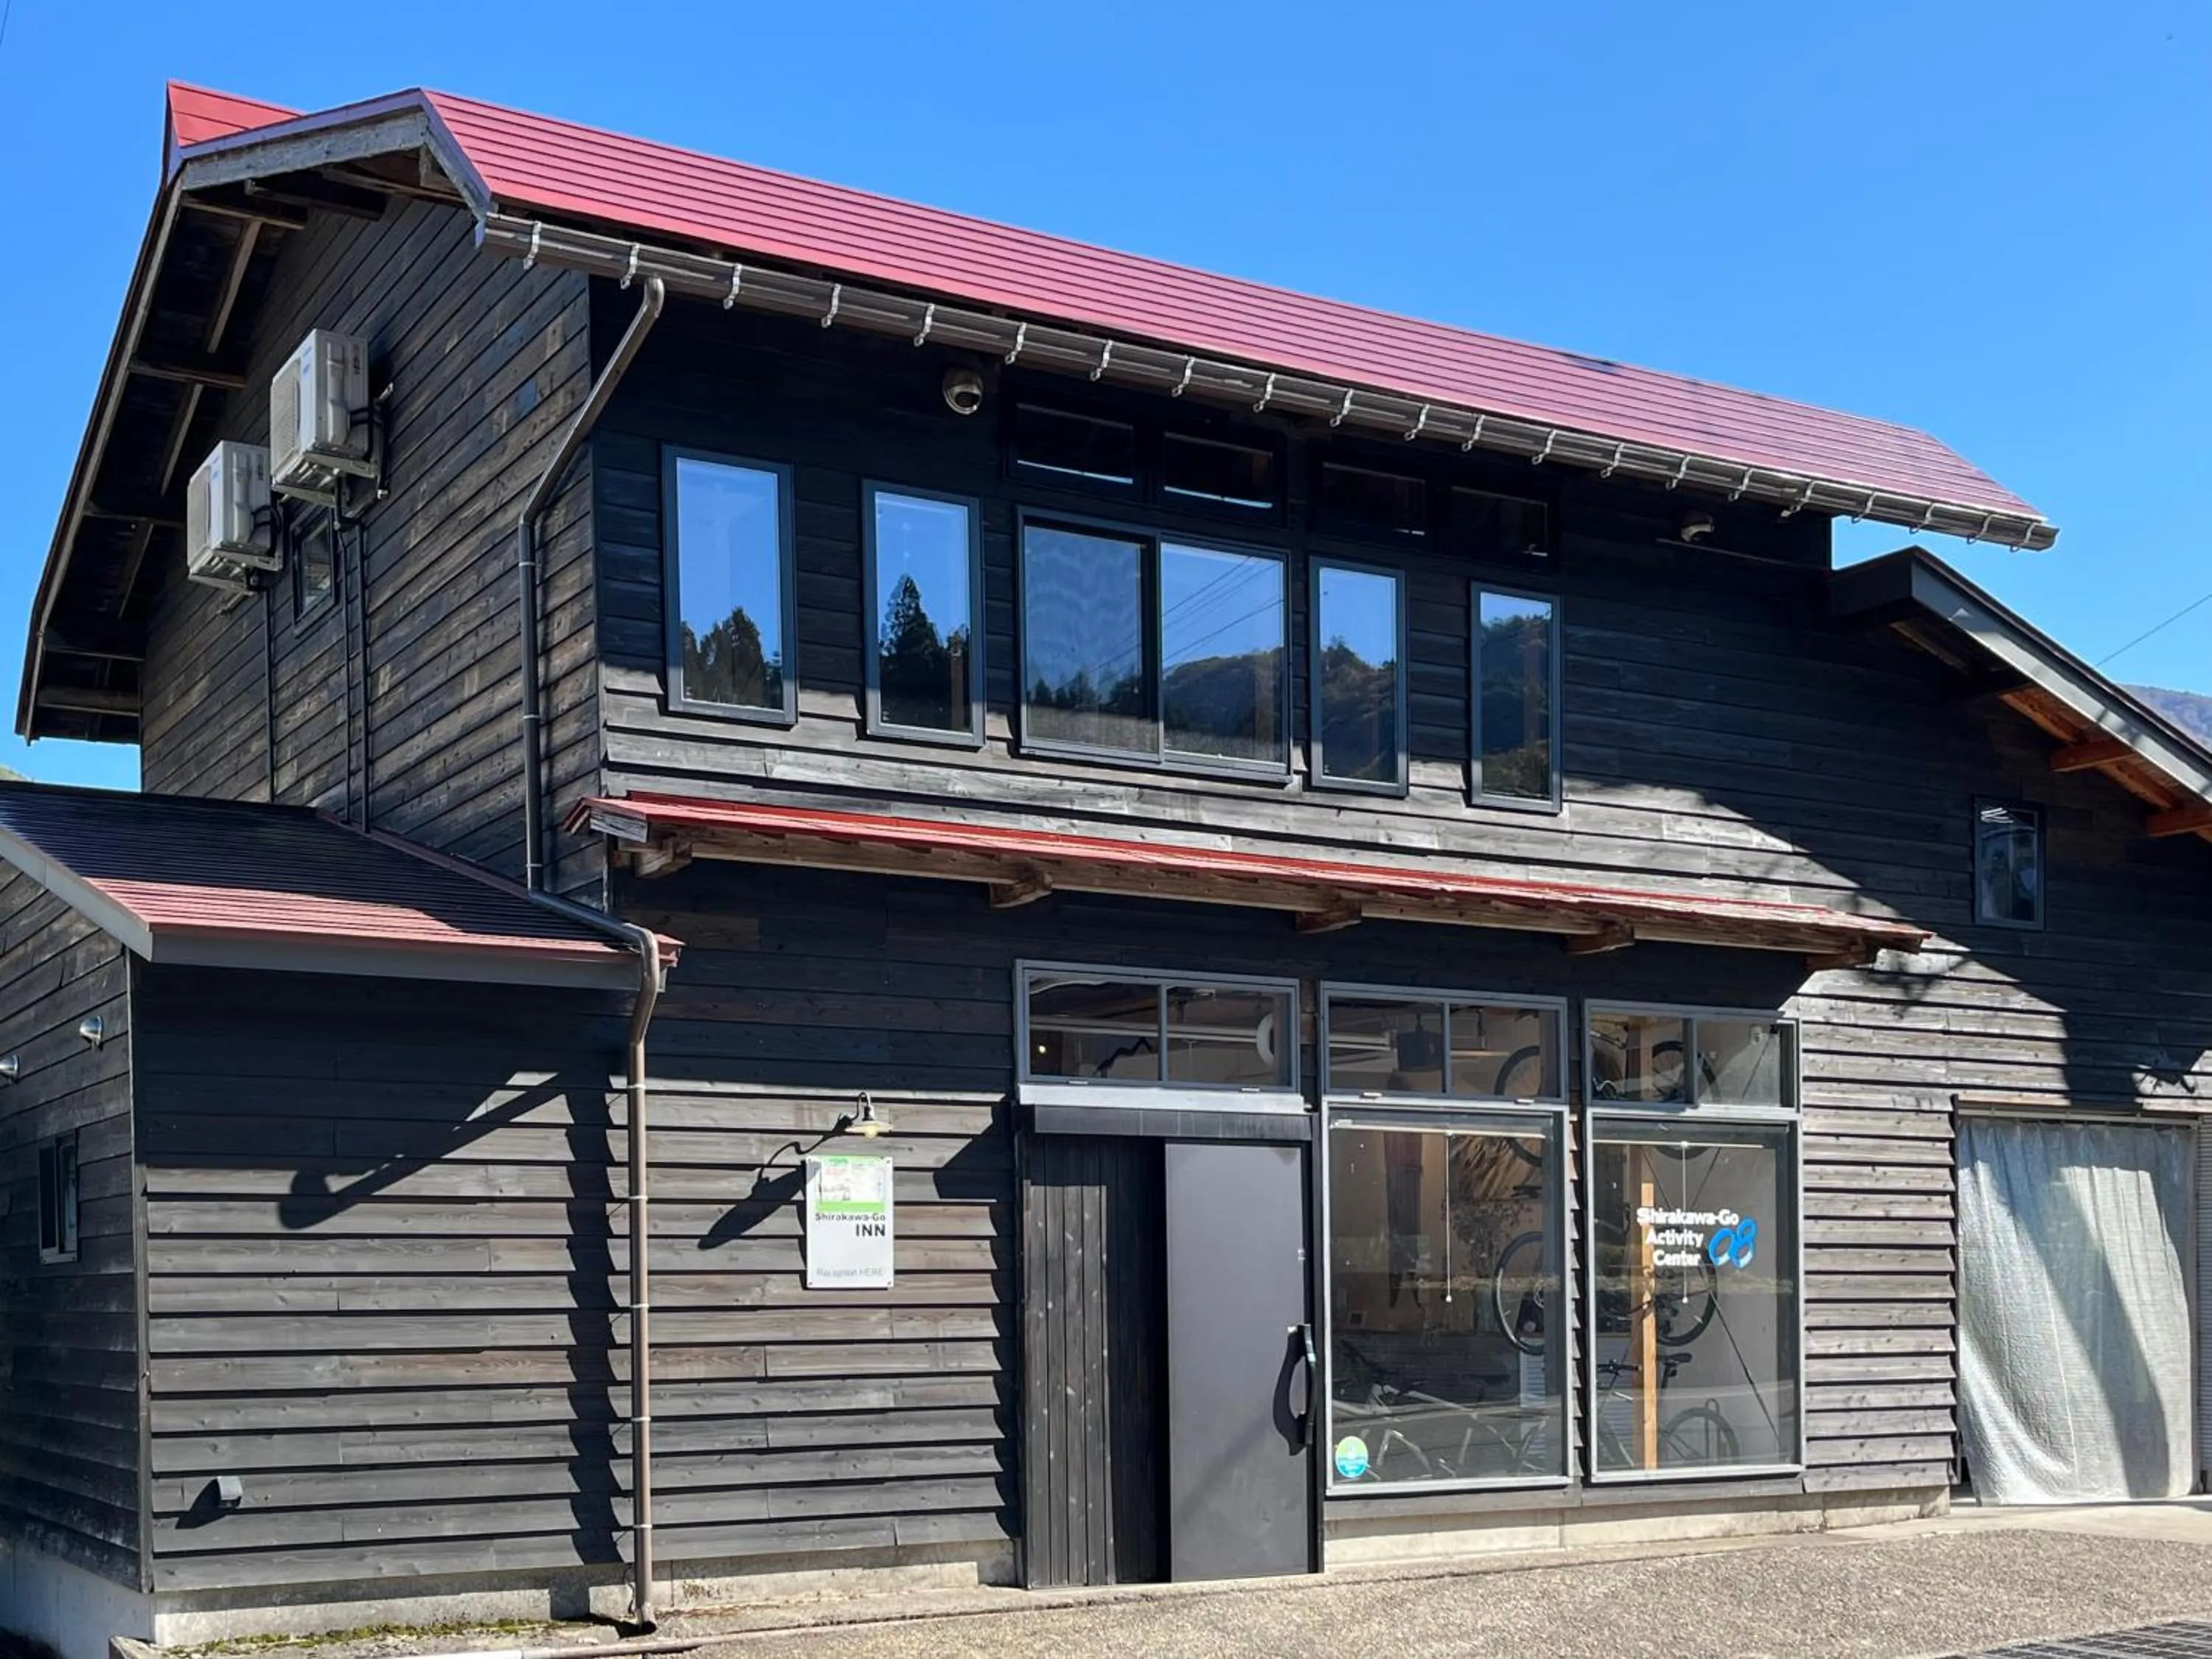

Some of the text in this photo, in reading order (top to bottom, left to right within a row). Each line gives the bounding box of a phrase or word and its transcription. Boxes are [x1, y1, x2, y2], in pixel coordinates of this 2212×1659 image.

[815, 1213, 886, 1221] Shirakawa-Go
[1636, 1208, 1739, 1225] Shirakawa-Go
[856, 1224, 886, 1237] INN
[1646, 1228, 1704, 1248] Activity
[1652, 1250, 1701, 1265] Center
